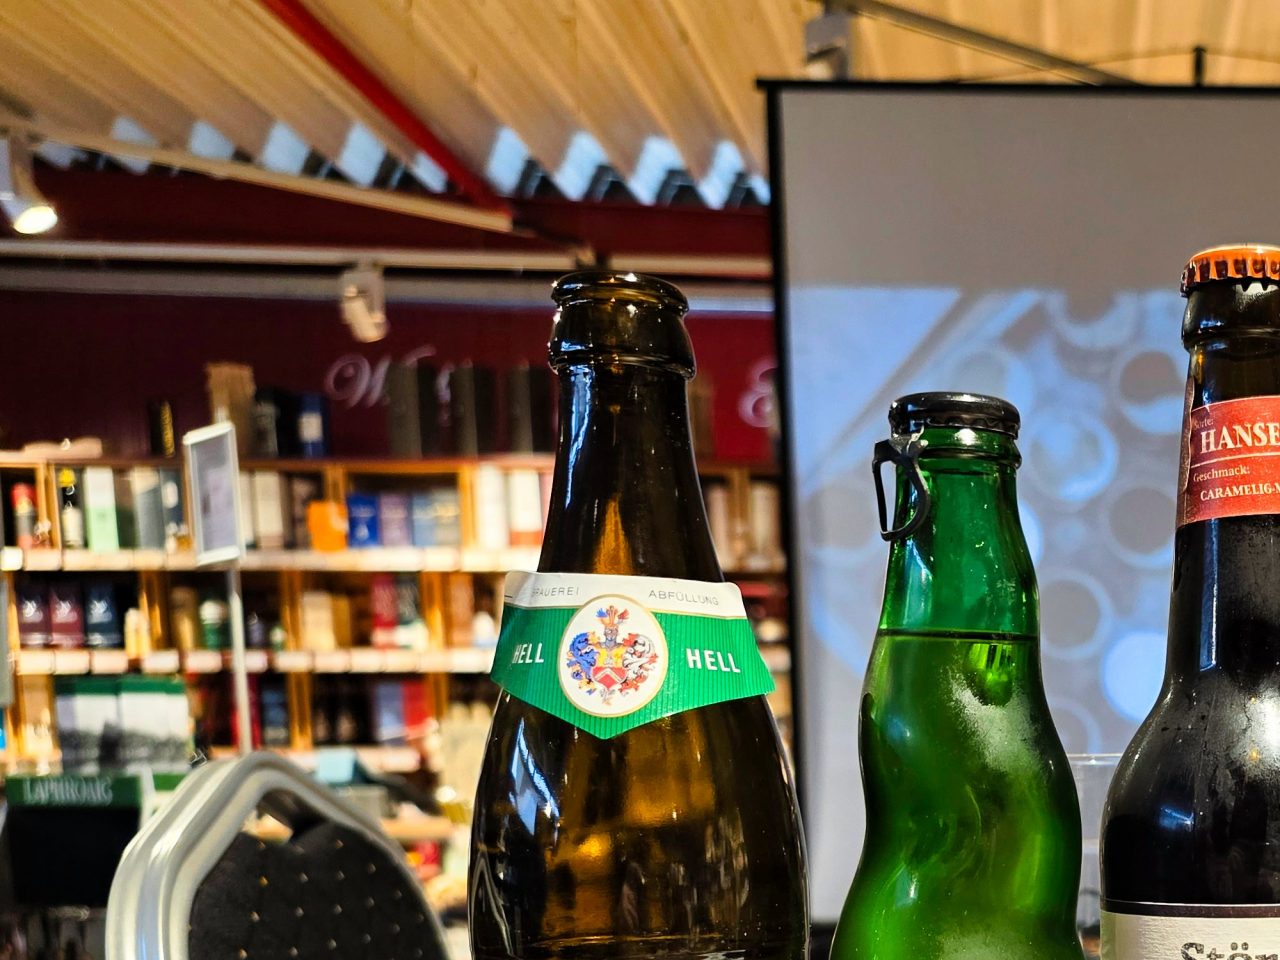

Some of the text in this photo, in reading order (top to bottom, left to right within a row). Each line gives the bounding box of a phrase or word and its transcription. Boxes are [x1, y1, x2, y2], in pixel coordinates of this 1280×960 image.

[1193, 465, 1250, 482] Geschmack:
[511, 643, 545, 664] HELL
[686, 647, 741, 673] HELL
